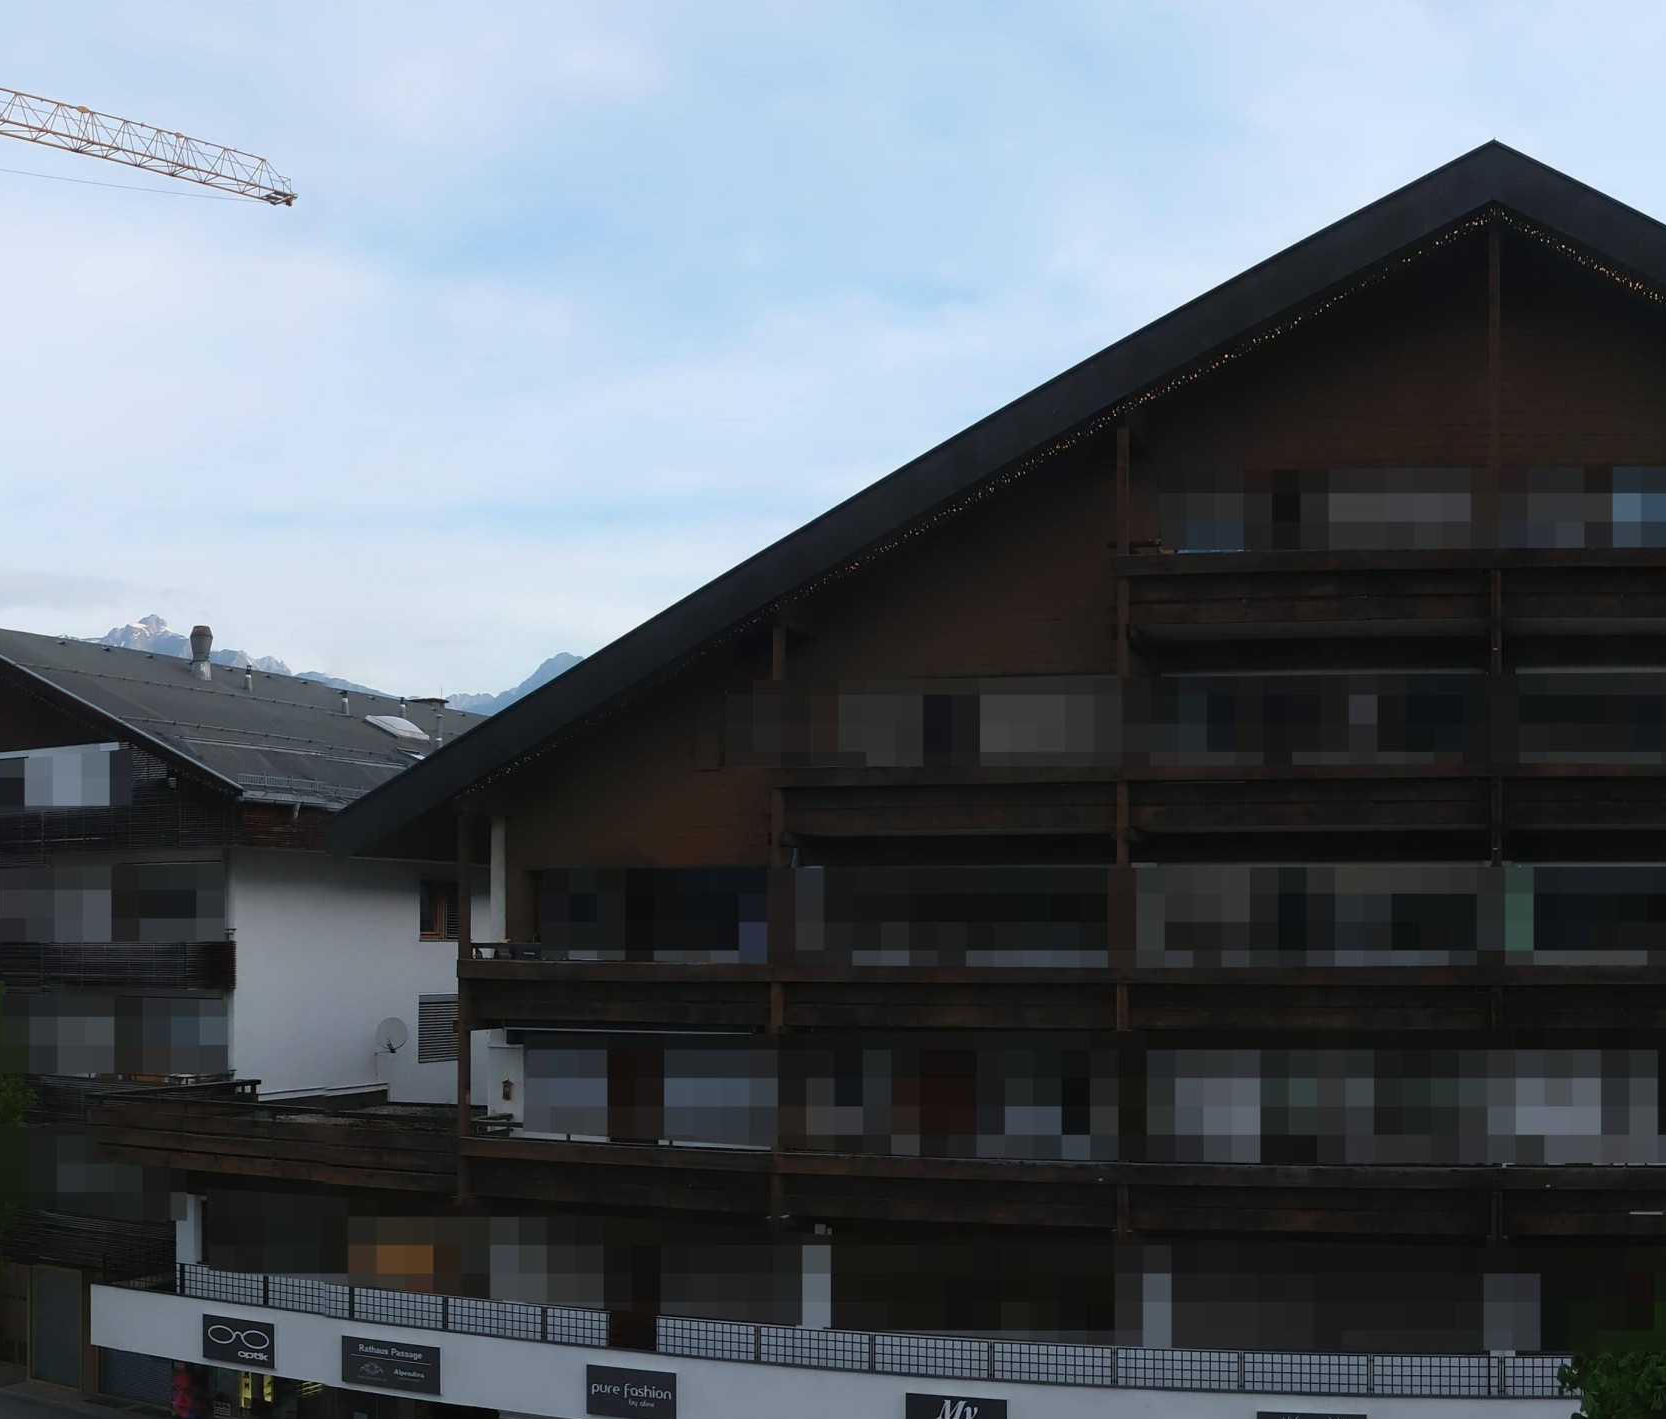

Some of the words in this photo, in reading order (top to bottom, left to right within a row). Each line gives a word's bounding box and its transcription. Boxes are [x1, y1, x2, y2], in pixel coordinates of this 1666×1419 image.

[237, 1350, 269, 1363] optik
[358, 1343, 389, 1356] Rathaus
[391, 1348, 423, 1361] Passage
[393, 1368, 425, 1379] Alpendiva
[591, 1382, 621, 1396] pure
[624, 1382, 672, 1400] fashion
[628, 1398, 638, 1408] by
[639, 1400, 655, 1409] alex
